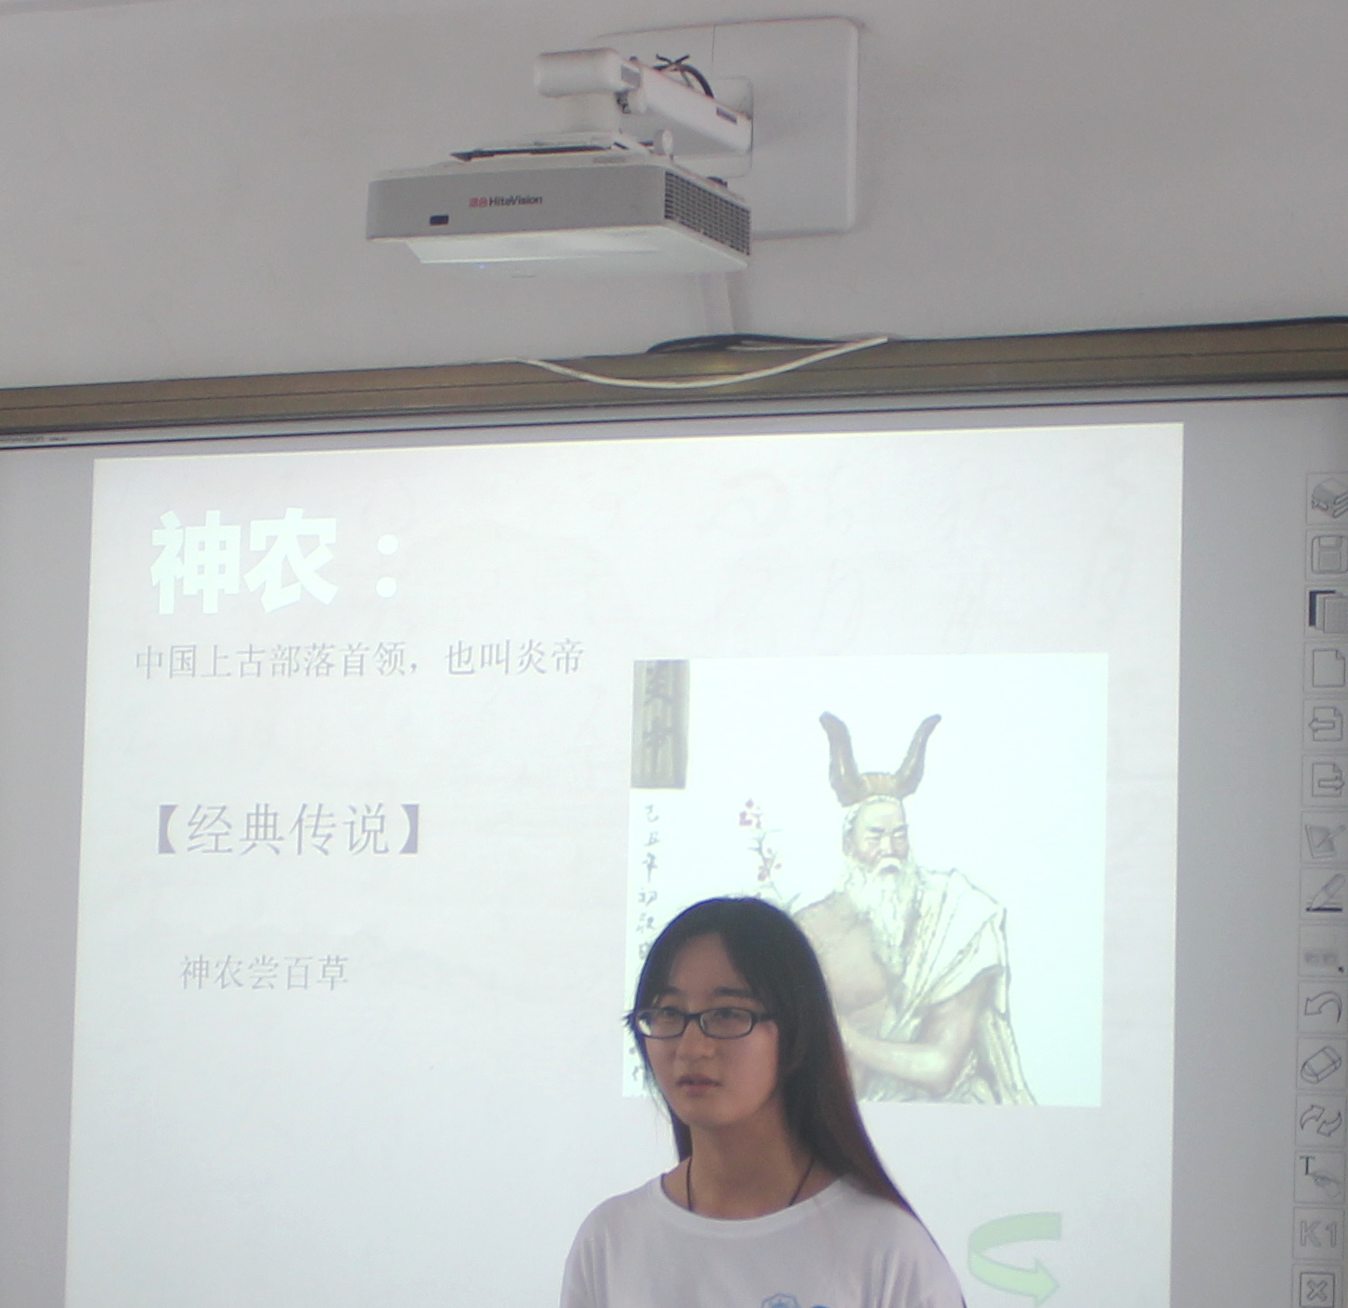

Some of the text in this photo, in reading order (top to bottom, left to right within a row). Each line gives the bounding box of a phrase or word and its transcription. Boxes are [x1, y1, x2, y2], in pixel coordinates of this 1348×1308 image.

[150, 507, 399, 614] 神农：
[135, 638, 585, 680] 中国上古部落首领，也叫炎帝
[179, 953, 350, 992] 神农尝百草
